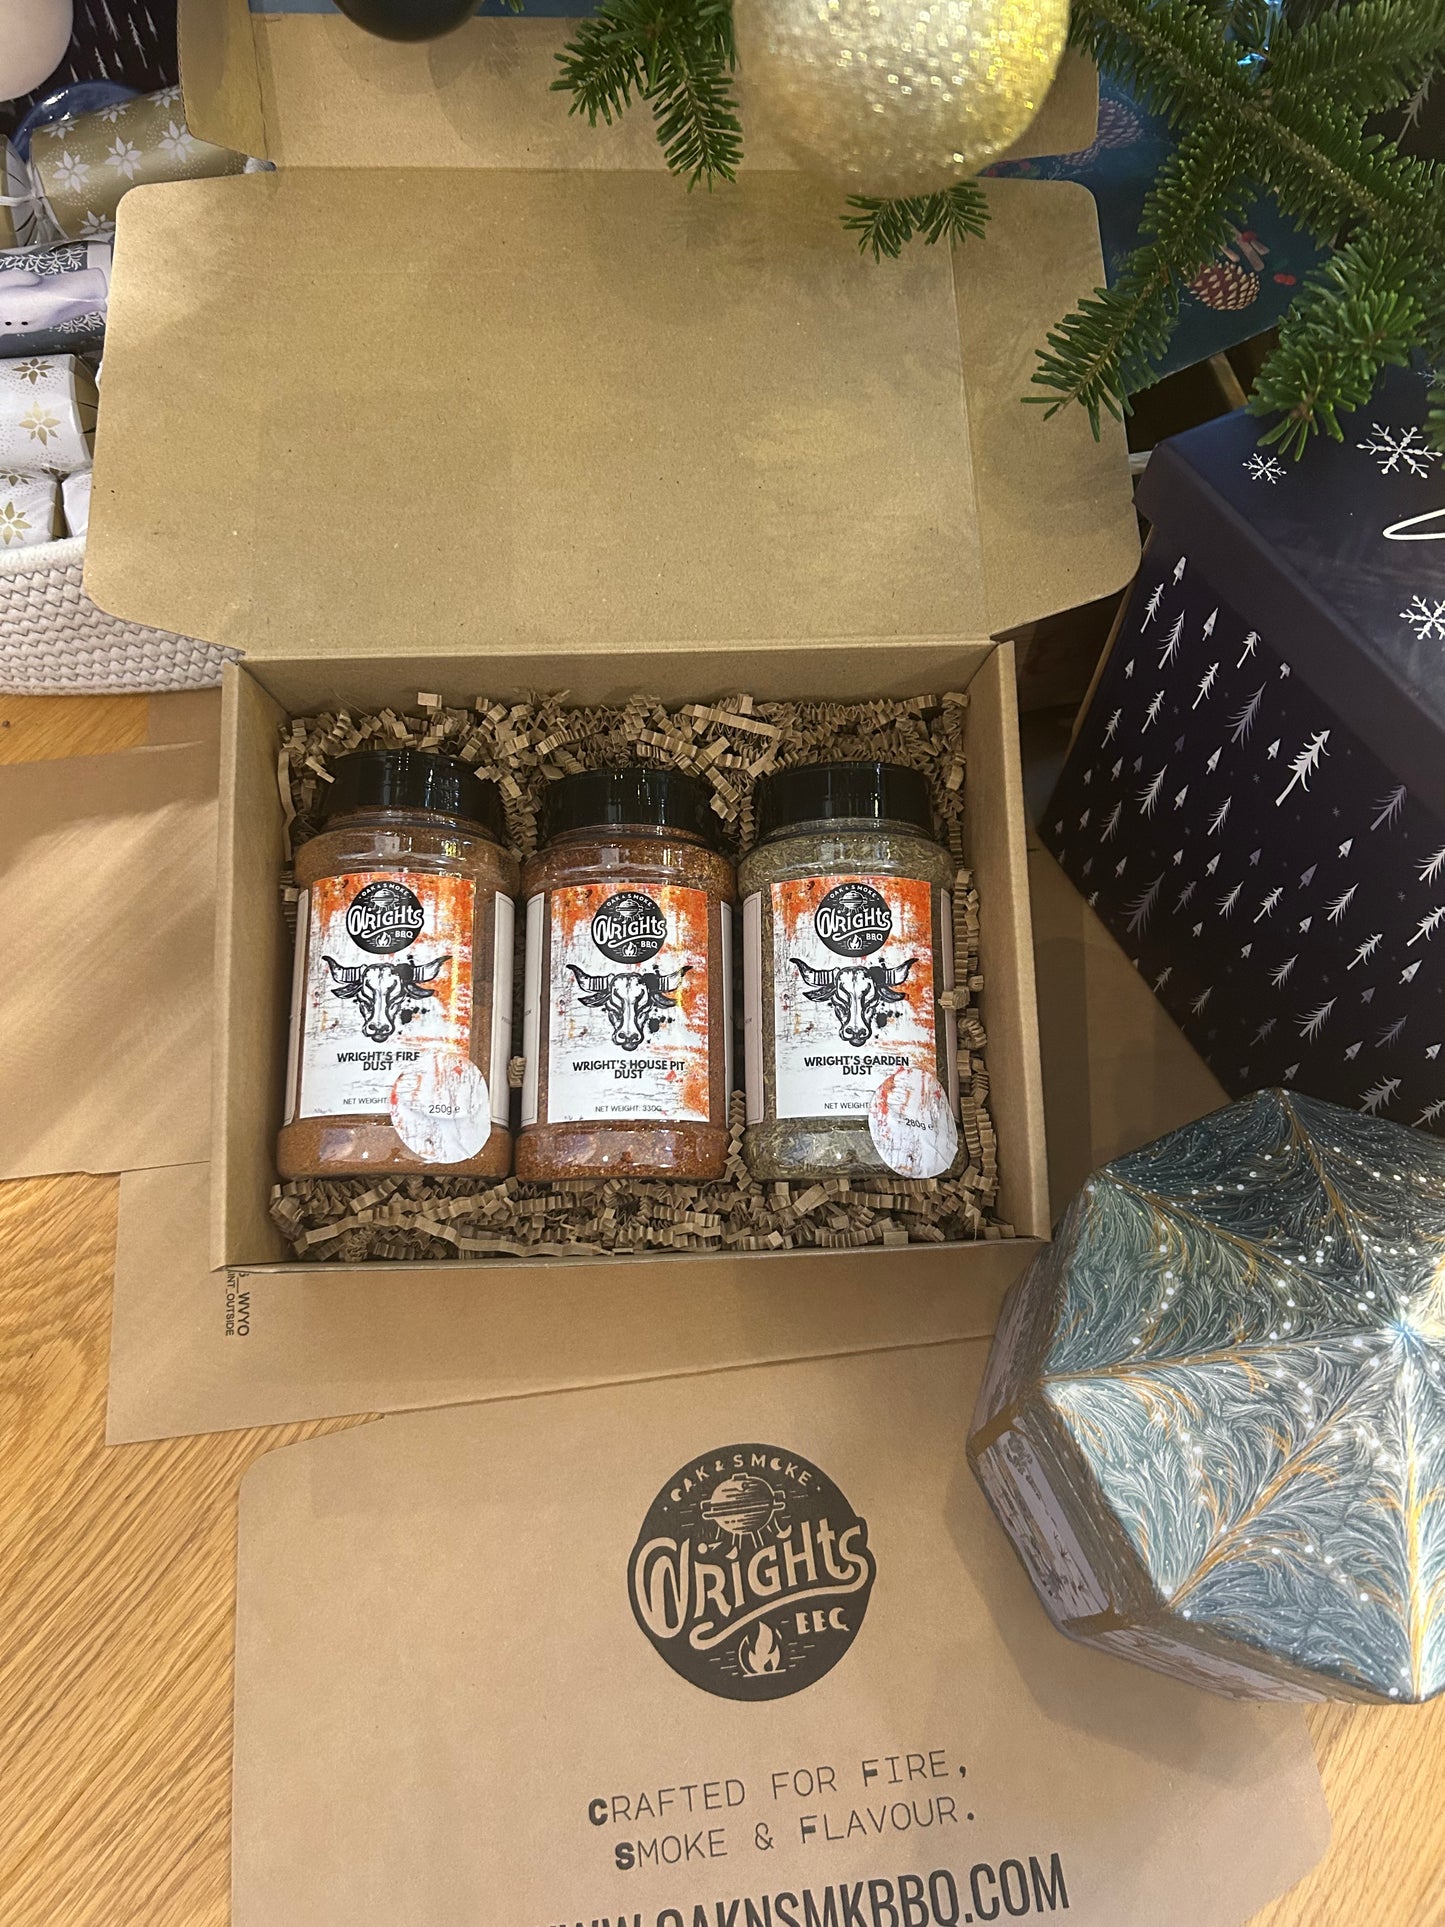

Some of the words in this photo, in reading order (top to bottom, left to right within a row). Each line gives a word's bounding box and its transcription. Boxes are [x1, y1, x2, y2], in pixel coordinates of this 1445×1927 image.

[362, 886, 376, 896] OAK
[383, 882, 410, 896] SMOKE
[830, 887, 844, 898] OAK
[852, 884, 877, 898] SMOKE
[606, 896, 620, 906] OAK
[628, 894, 653, 907] SMOKE
[395, 930, 414, 938] BBQ
[866, 933, 883, 941] BBQ
[640, 940, 658, 949] BBQ
[336, 1052, 392, 1062] WRIGHT'S
[804, 1055, 860, 1066] WRIGHT'S
[864, 1055, 909, 1066] GARDEN
[363, 1061, 393, 1071] DUST
[573, 1060, 626, 1071] WRIGHT'S
[630, 1060, 667, 1070] HOUSE
[670, 1061, 685, 1070] PIT
[843, 1065, 872, 1075] DUST
[614, 1069, 644, 1079] DUST
[428, 1104, 452, 1116] 250g
[905, 1118, 926, 1130] 280g
[733, 1453, 812, 1486] SMOKE
[588, 1779, 745, 1826] CRAFTED
[772, 1766, 837, 1800] FOR
[862, 1750, 966, 1787] FIRE,
[614, 1828, 728, 1870] SMOKE
[755, 1822, 774, 1850] &
[800, 1796, 974, 1844] FLAVOUR.
